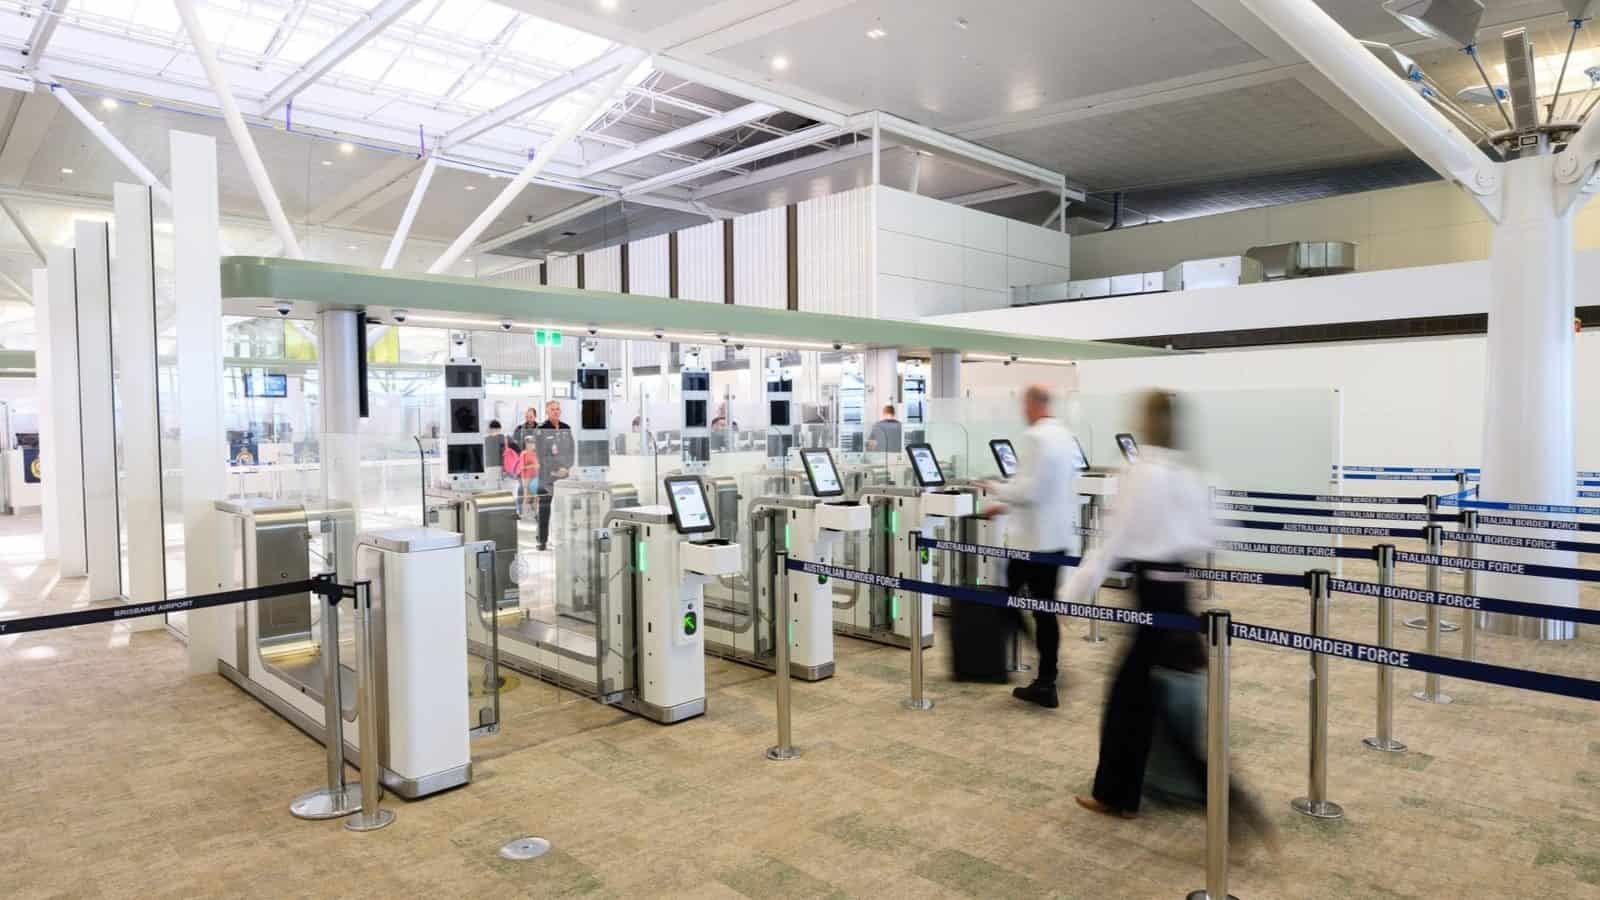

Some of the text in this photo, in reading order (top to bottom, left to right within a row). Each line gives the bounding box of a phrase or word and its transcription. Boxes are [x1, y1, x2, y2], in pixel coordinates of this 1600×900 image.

[1333, 510, 1430, 521] AUSTRALIAN BORDER FORCE
[1514, 518, 1549, 528] BORDER
[1551, 521, 1579, 530] FORCE
[1283, 523, 1390, 536] AUSTRALIAN BORDER FORCE
[936, 541, 1031, 561] AUSTRALIAN BORDER FORCE
[1270, 544, 1304, 555] BORDER
[1306, 546, 1336, 557] FORCE
[1484, 535, 1522, 546] BORDER
[1525, 539, 1556, 550] FORCE
[1397, 552, 1525, 574] TRALIAN BORDER FORCE
[803, 563, 901, 588] AUSTRALIAN BORDER FORCE
[1230, 572, 1264, 584] FORCE
[1331, 579, 1481, 610] TRALIAN BORDER FORCE
[1007, 597, 1153, 625] AUSTRALIAN BORDER FORCE
[1232, 622, 1410, 667] TRALIAN BORDER FORCE
